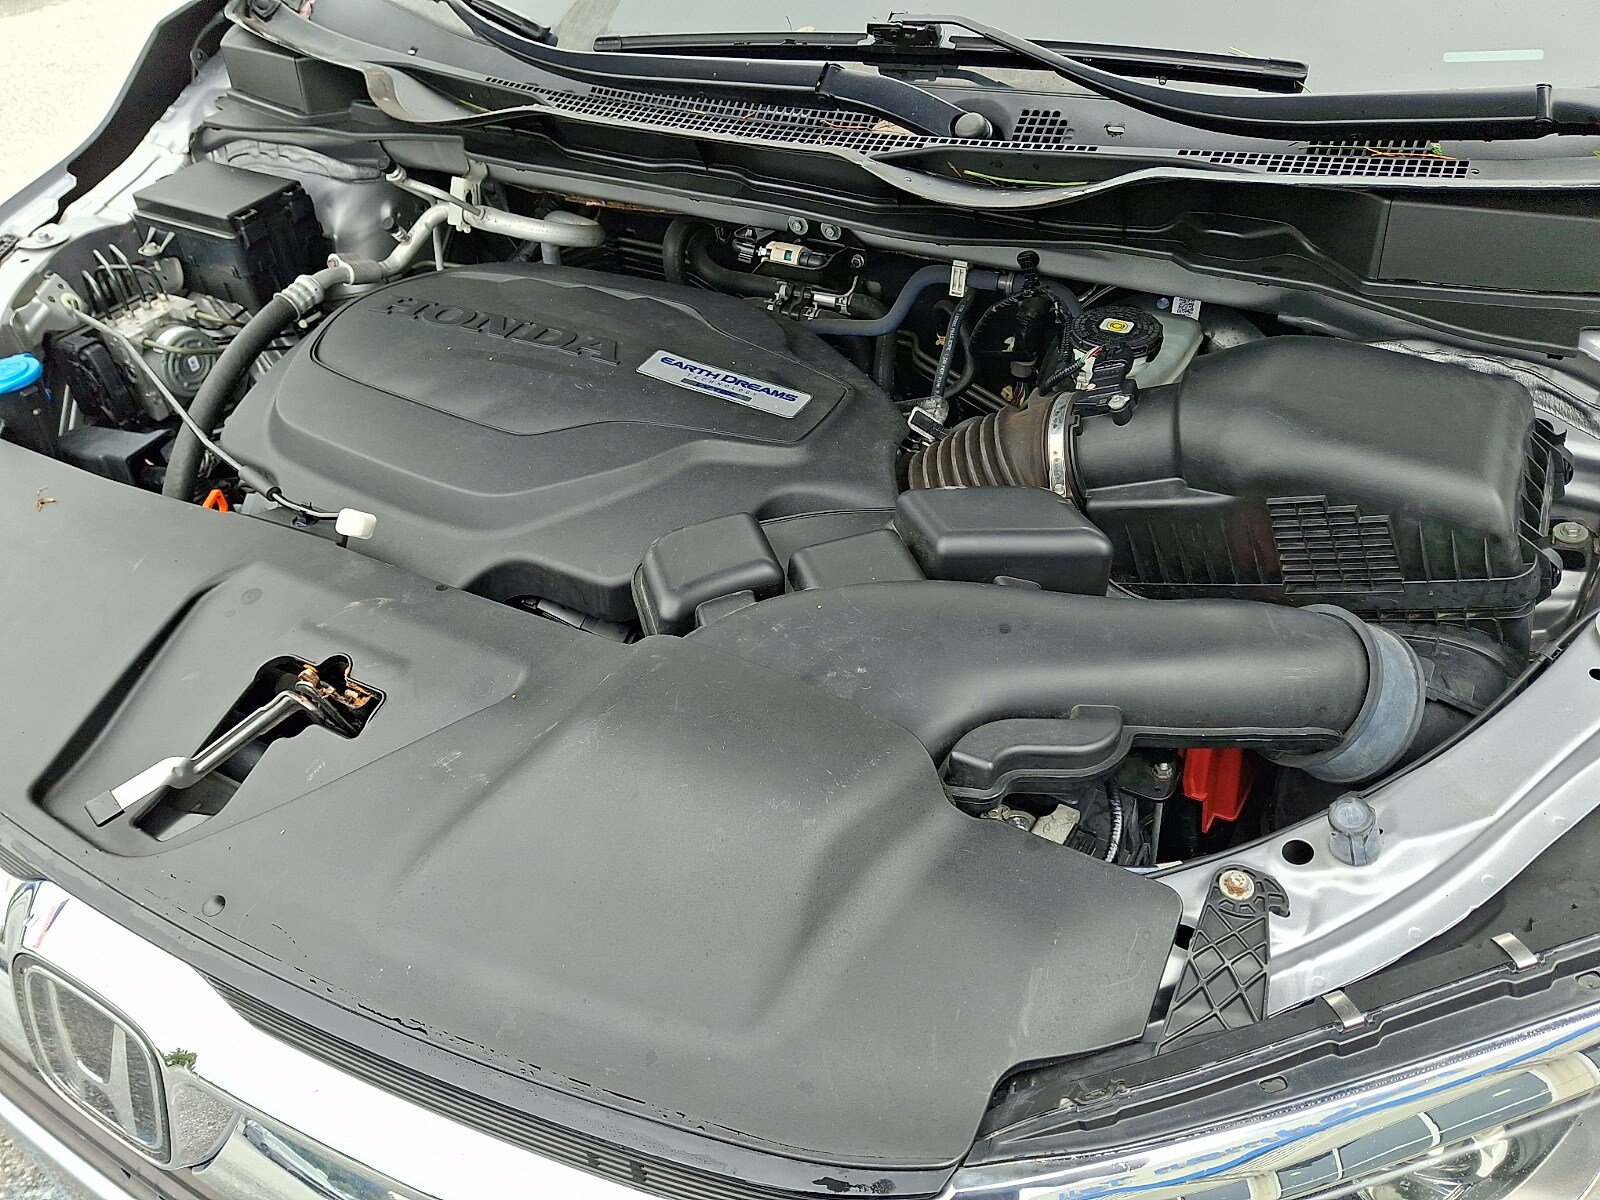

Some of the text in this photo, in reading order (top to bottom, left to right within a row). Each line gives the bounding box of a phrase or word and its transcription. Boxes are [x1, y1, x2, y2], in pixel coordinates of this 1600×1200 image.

[369, 297, 621, 366] HONDA
[660, 356, 721, 380] EARTH
[720, 374, 799, 402] DREAMS
[687, 373, 757, 397] TECHNOLOGY
